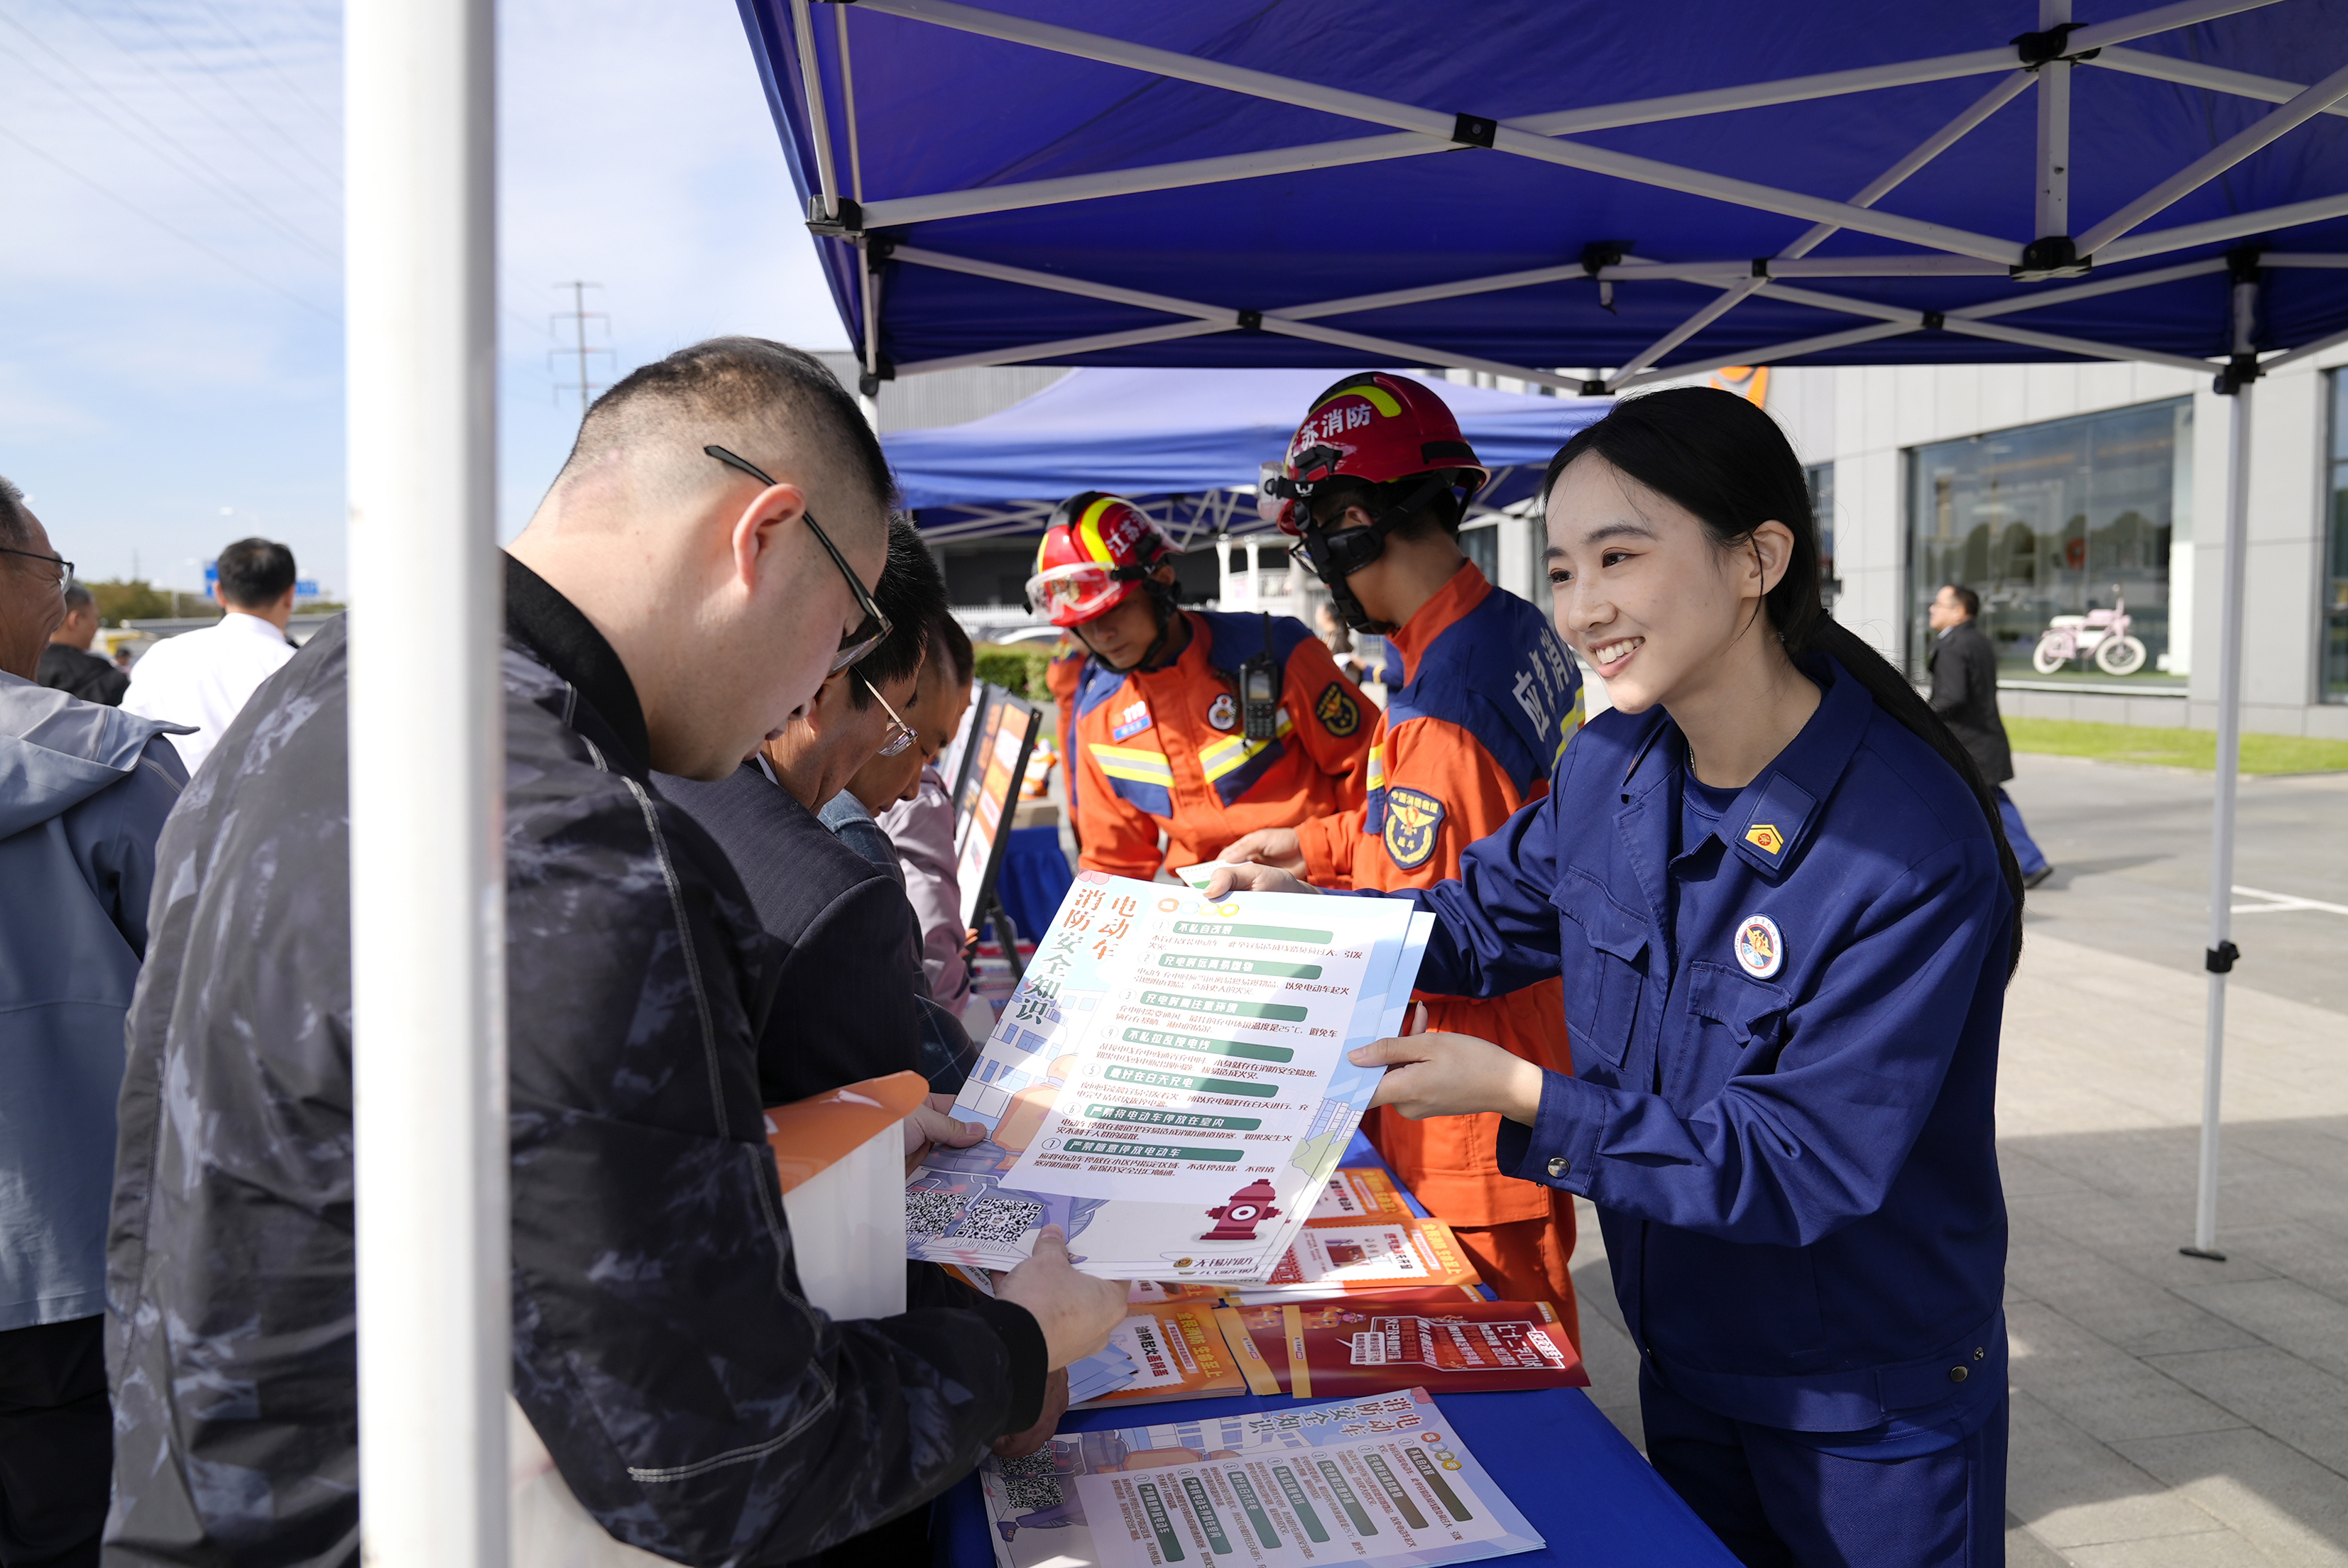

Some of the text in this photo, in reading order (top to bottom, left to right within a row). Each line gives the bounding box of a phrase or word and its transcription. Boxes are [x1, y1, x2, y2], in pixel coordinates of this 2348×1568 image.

[1105, 511, 1149, 558] 江苏消
[1123, 700, 1147, 724] 119
[1391, 790, 1439, 814] 中国消防救援
[1093, 896, 1136, 960] 电动车
[1176, 923, 1233, 934] 不私自改装
[1016, 889, 1105, 1025] 消防安全知识
[1162, 955, 1255, 972] 充电时远离易燃物
[1127, 1030, 1212, 1050] 不私拉乱接电线
[1108, 1067, 1194, 1087] 最好在白天充电
[1088, 1107, 1224, 1127] 严禁将电动车停放在室内
[1068, 1141, 1181, 1157] 严禁随意停放电动车
[1194, 1256, 1255, 1268] 无锡消防
[1134, 1325, 1169, 1377] 油锅起火盖锅盖
[1176, 1312, 1223, 1378] 全民消防 生命至上
[1495, 1325, 1545, 1367] 七十二字口诀
[1245, 1396, 1414, 1435] 消防安全知识
[1339, 1413, 1423, 1437] 电动车
[1407, 1449, 1436, 1476] 不私自改装
[1230, 1473, 1258, 1510] 最好在白天充电
[1274, 1467, 1306, 1505] 不私拉乱接电线
[1140, 1485, 1170, 1533] 严禁随意停放电动车
[1184, 1479, 1221, 1537] 严禁将电动车停放在室内
